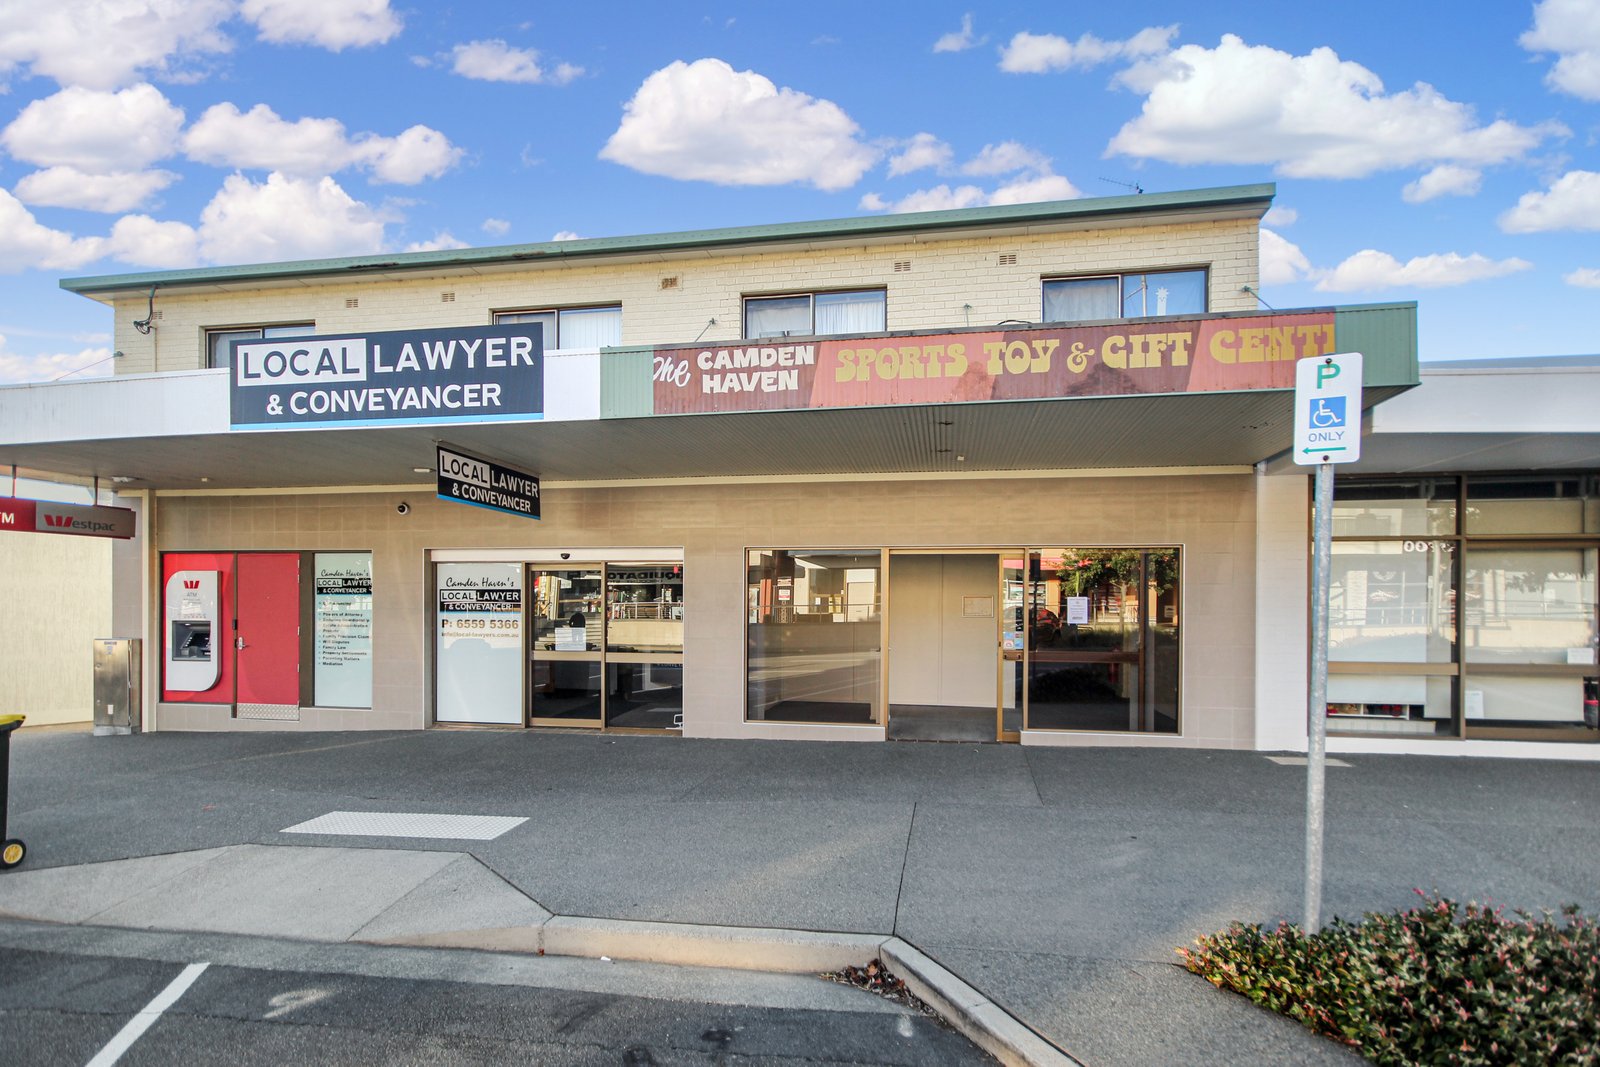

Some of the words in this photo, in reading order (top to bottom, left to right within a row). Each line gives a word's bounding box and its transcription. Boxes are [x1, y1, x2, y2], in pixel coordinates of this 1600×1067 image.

[243, 347, 360, 379] LOCAL
[373, 336, 534, 373] LAWYER
[697, 345, 815, 370] CAMDEN
[835, 342, 968, 383] SPORTS
[983, 339, 1060, 376] TOY
[1066, 342, 1095, 373] &
[1101, 332, 1193, 369] GIFT
[702, 369, 799, 394] HAVEN
[1316, 363, 1341, 389] P
[267, 394, 283, 415] &
[290, 383, 501, 415] CONVEYANCER
[1308, 430, 1344, 442] ONLY
[441, 455, 488, 483] LOCAL
[491, 470, 538, 498] LAWYER
[452, 483, 459, 496] &
[461, 484, 531, 513] CONVEYANCER
[44, 514, 116, 532] Westpac
[321, 569, 344, 577] Camden
[345, 569, 369, 577] Haven's
[446, 577, 479, 587] Camden
[482, 577, 514, 587] Haven's
[441, 592, 474, 600] LOCAL
[477, 592, 519, 600] LAWYER
[441, 619, 452, 628] P:
[456, 619, 485, 628] 6559
[489, 619, 519, 629] 5366
